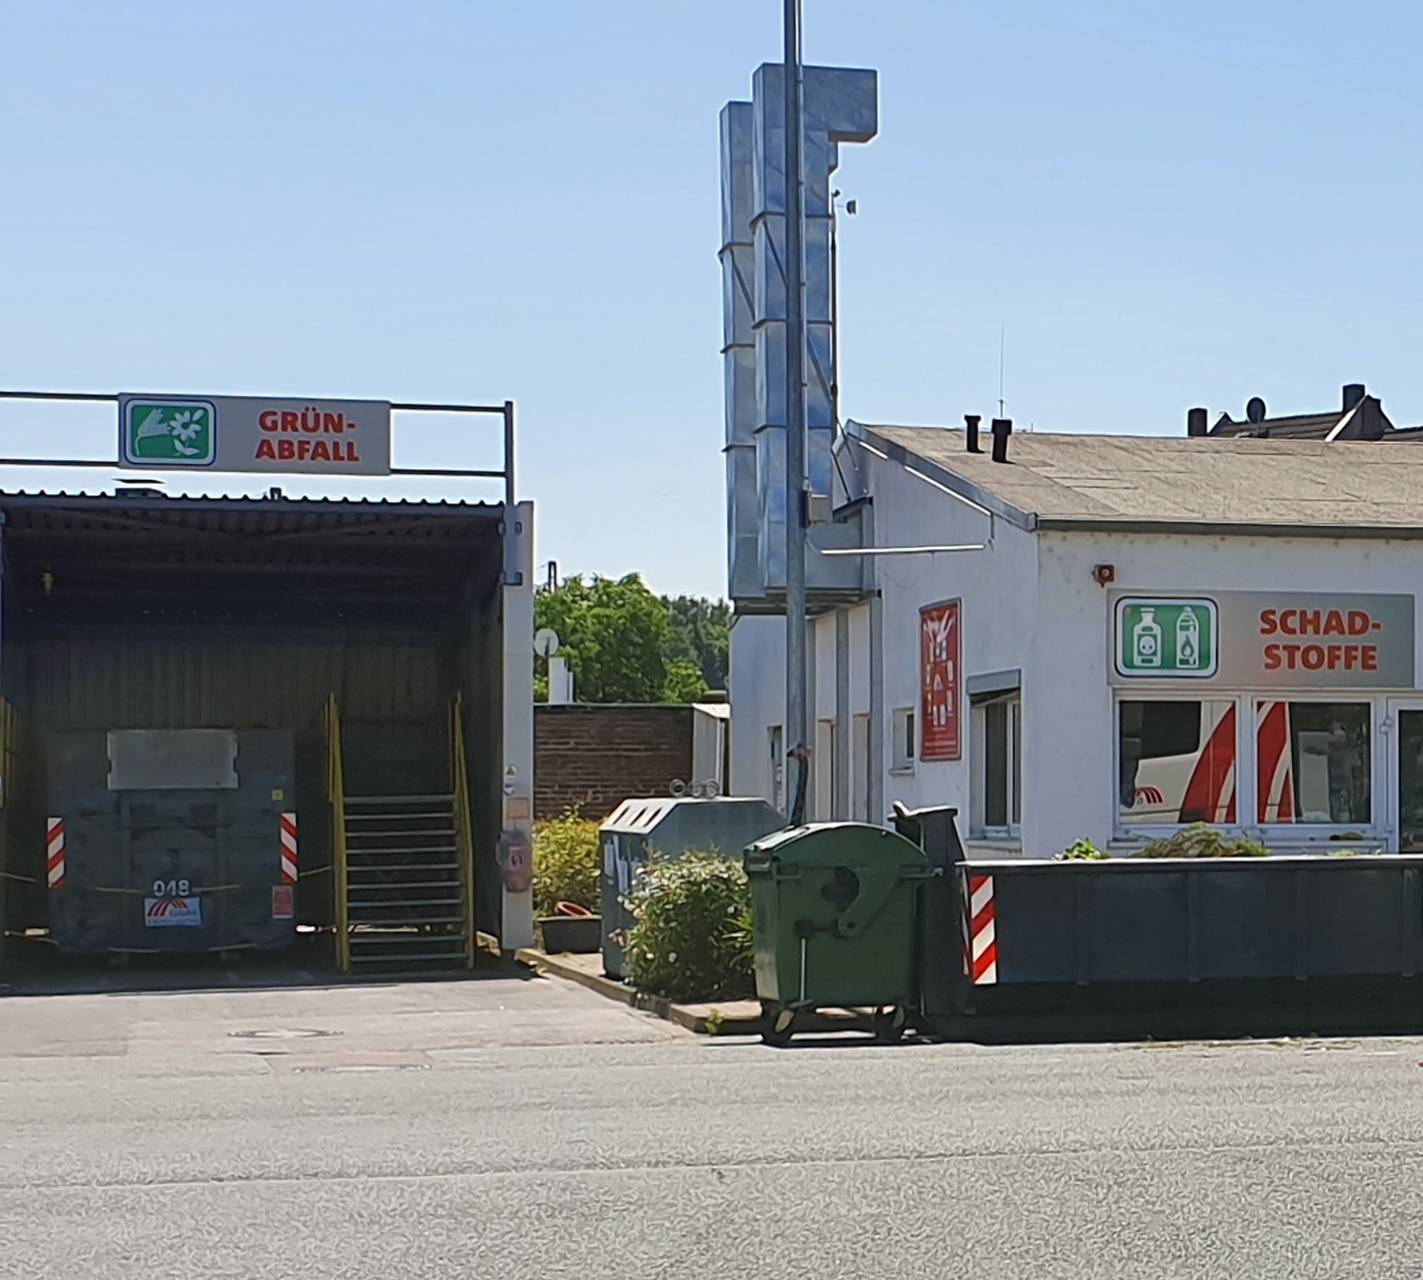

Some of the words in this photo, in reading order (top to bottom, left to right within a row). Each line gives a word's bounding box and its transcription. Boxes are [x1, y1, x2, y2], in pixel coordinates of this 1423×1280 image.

[258, 406, 356, 433] GRÜN-
[255, 439, 359, 461] ABFALL
[1260, 609, 1381, 635] SCHAD-
[1264, 644, 1377, 670] STOFFE
